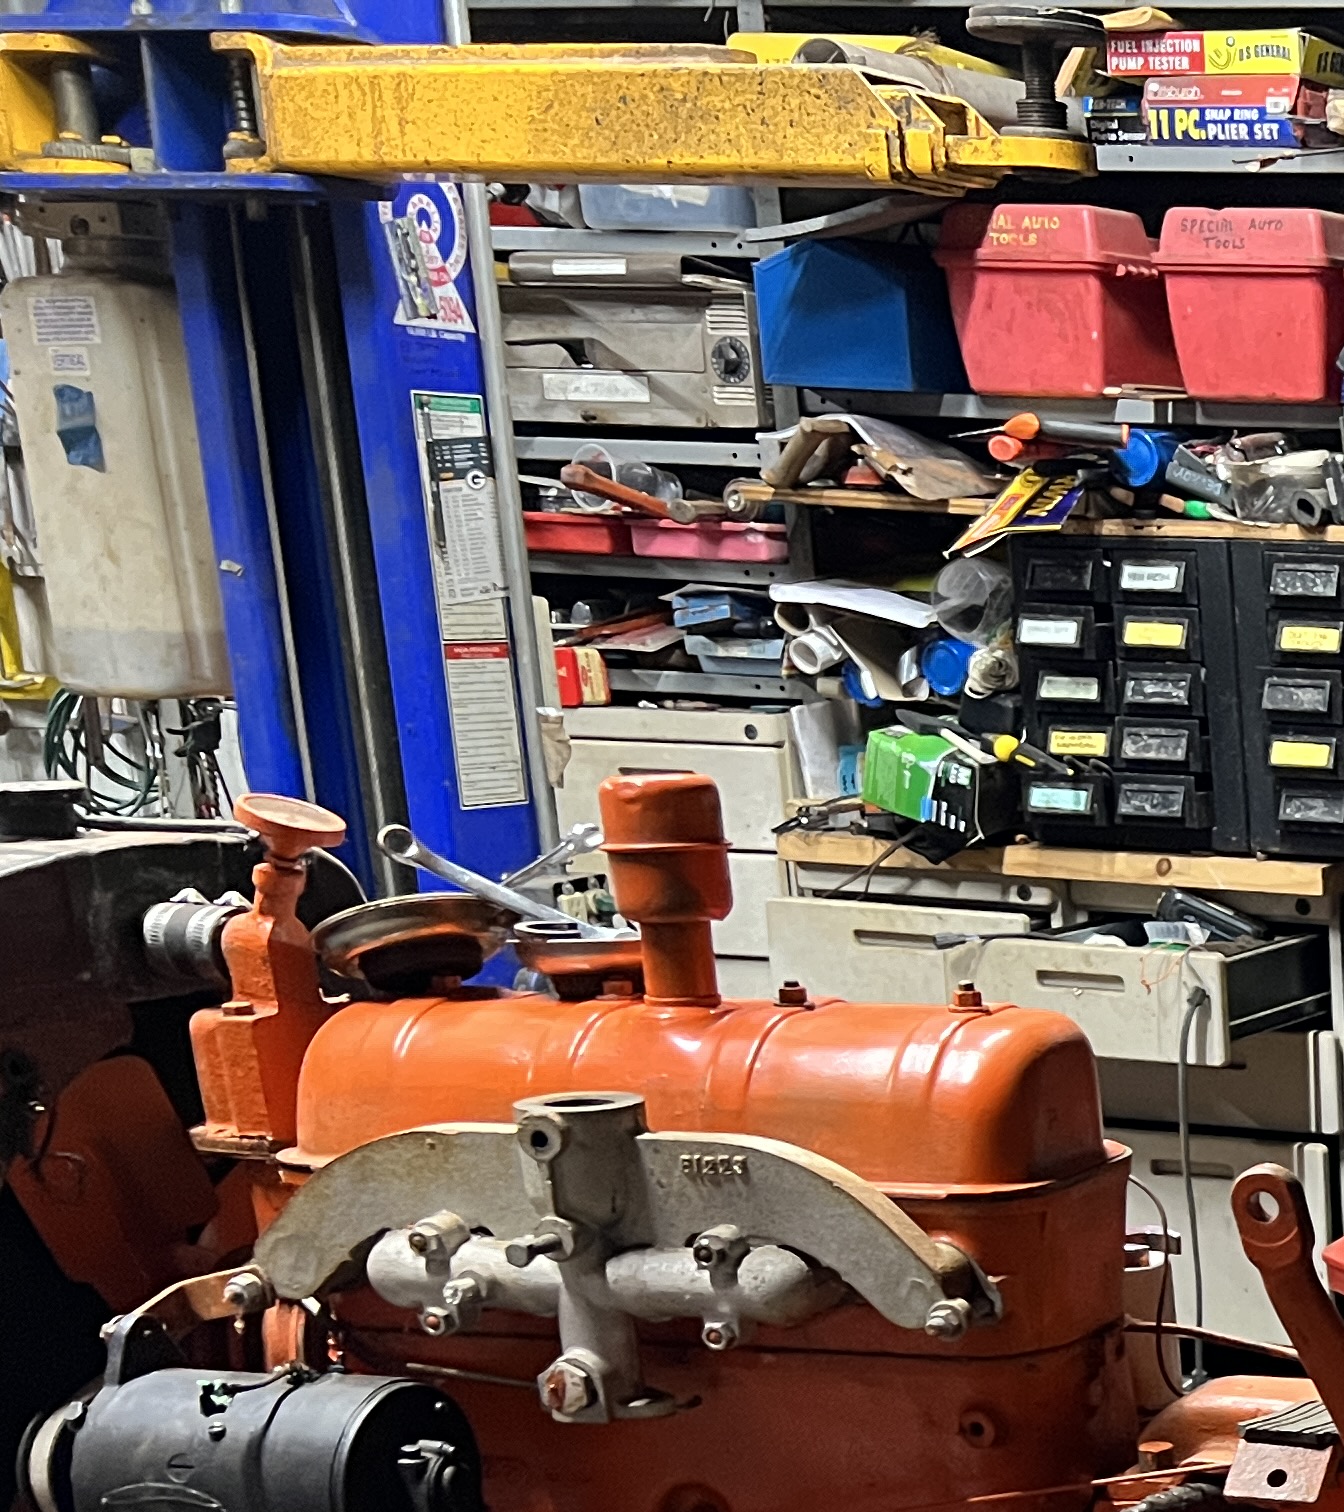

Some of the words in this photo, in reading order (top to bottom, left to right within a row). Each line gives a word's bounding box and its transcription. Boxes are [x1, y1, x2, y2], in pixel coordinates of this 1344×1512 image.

[1110, 40, 1137, 53] FUEL
[1141, 38, 1201, 53] INJECTION
[1254, 44, 1292, 62] GENERAL
[1111, 56, 1144, 71] PUMP
[1148, 55, 1190, 71] TESTER
[1205, 108, 1232, 121] SNAP
[1233, 108, 1260, 120] RING
[1148, 108, 1171, 141] 11
[1207, 123, 1250, 141] PLIER
[1253, 123, 1280, 141] SET
[1021, 215, 1061, 230] AUTO
[1247, 217, 1284, 231] AUTO
[1202, 236, 1246, 250] TOOLS
